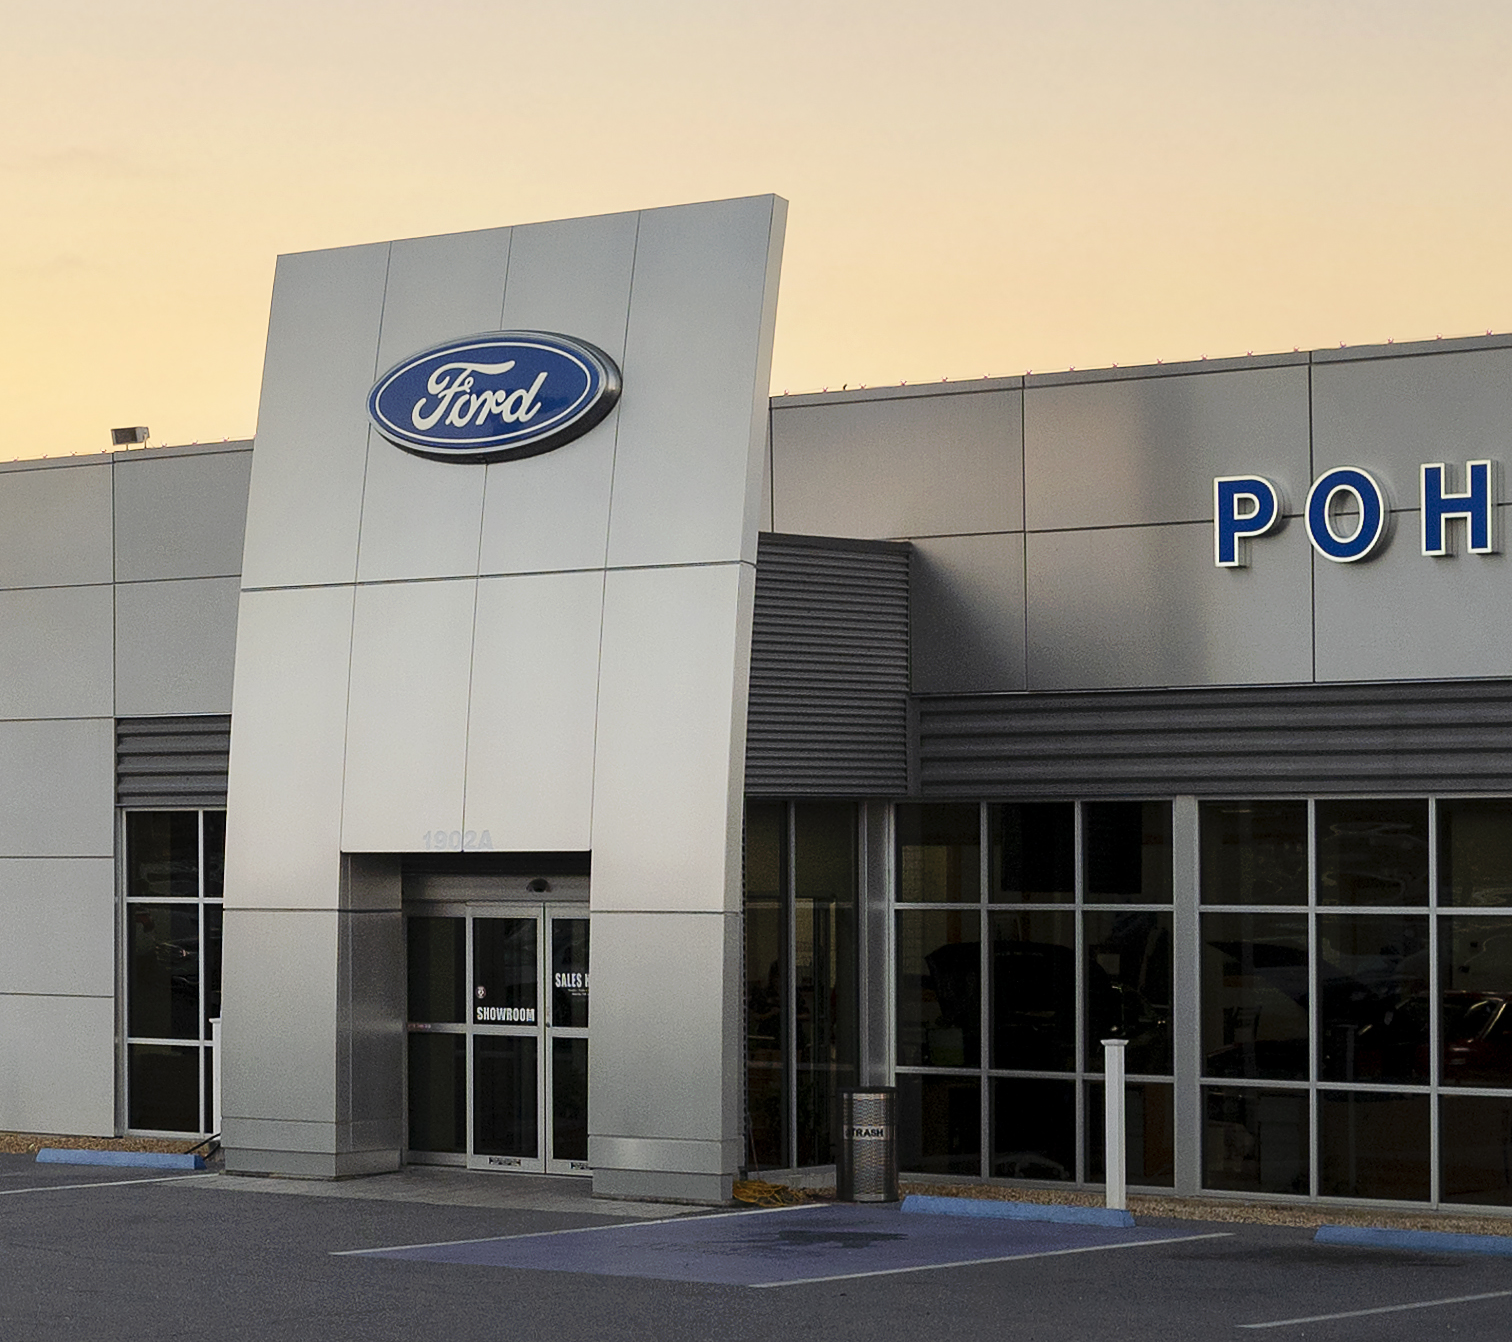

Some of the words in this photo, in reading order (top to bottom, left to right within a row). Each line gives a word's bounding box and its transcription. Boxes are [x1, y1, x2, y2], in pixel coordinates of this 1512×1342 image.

[410, 360, 542, 431] Ford
[422, 829, 494, 851] 1902A
[554, 972, 583, 988] SALES
[476, 1006, 535, 1022] SHOWROOM
[851, 1128, 884, 1138] TRASH
